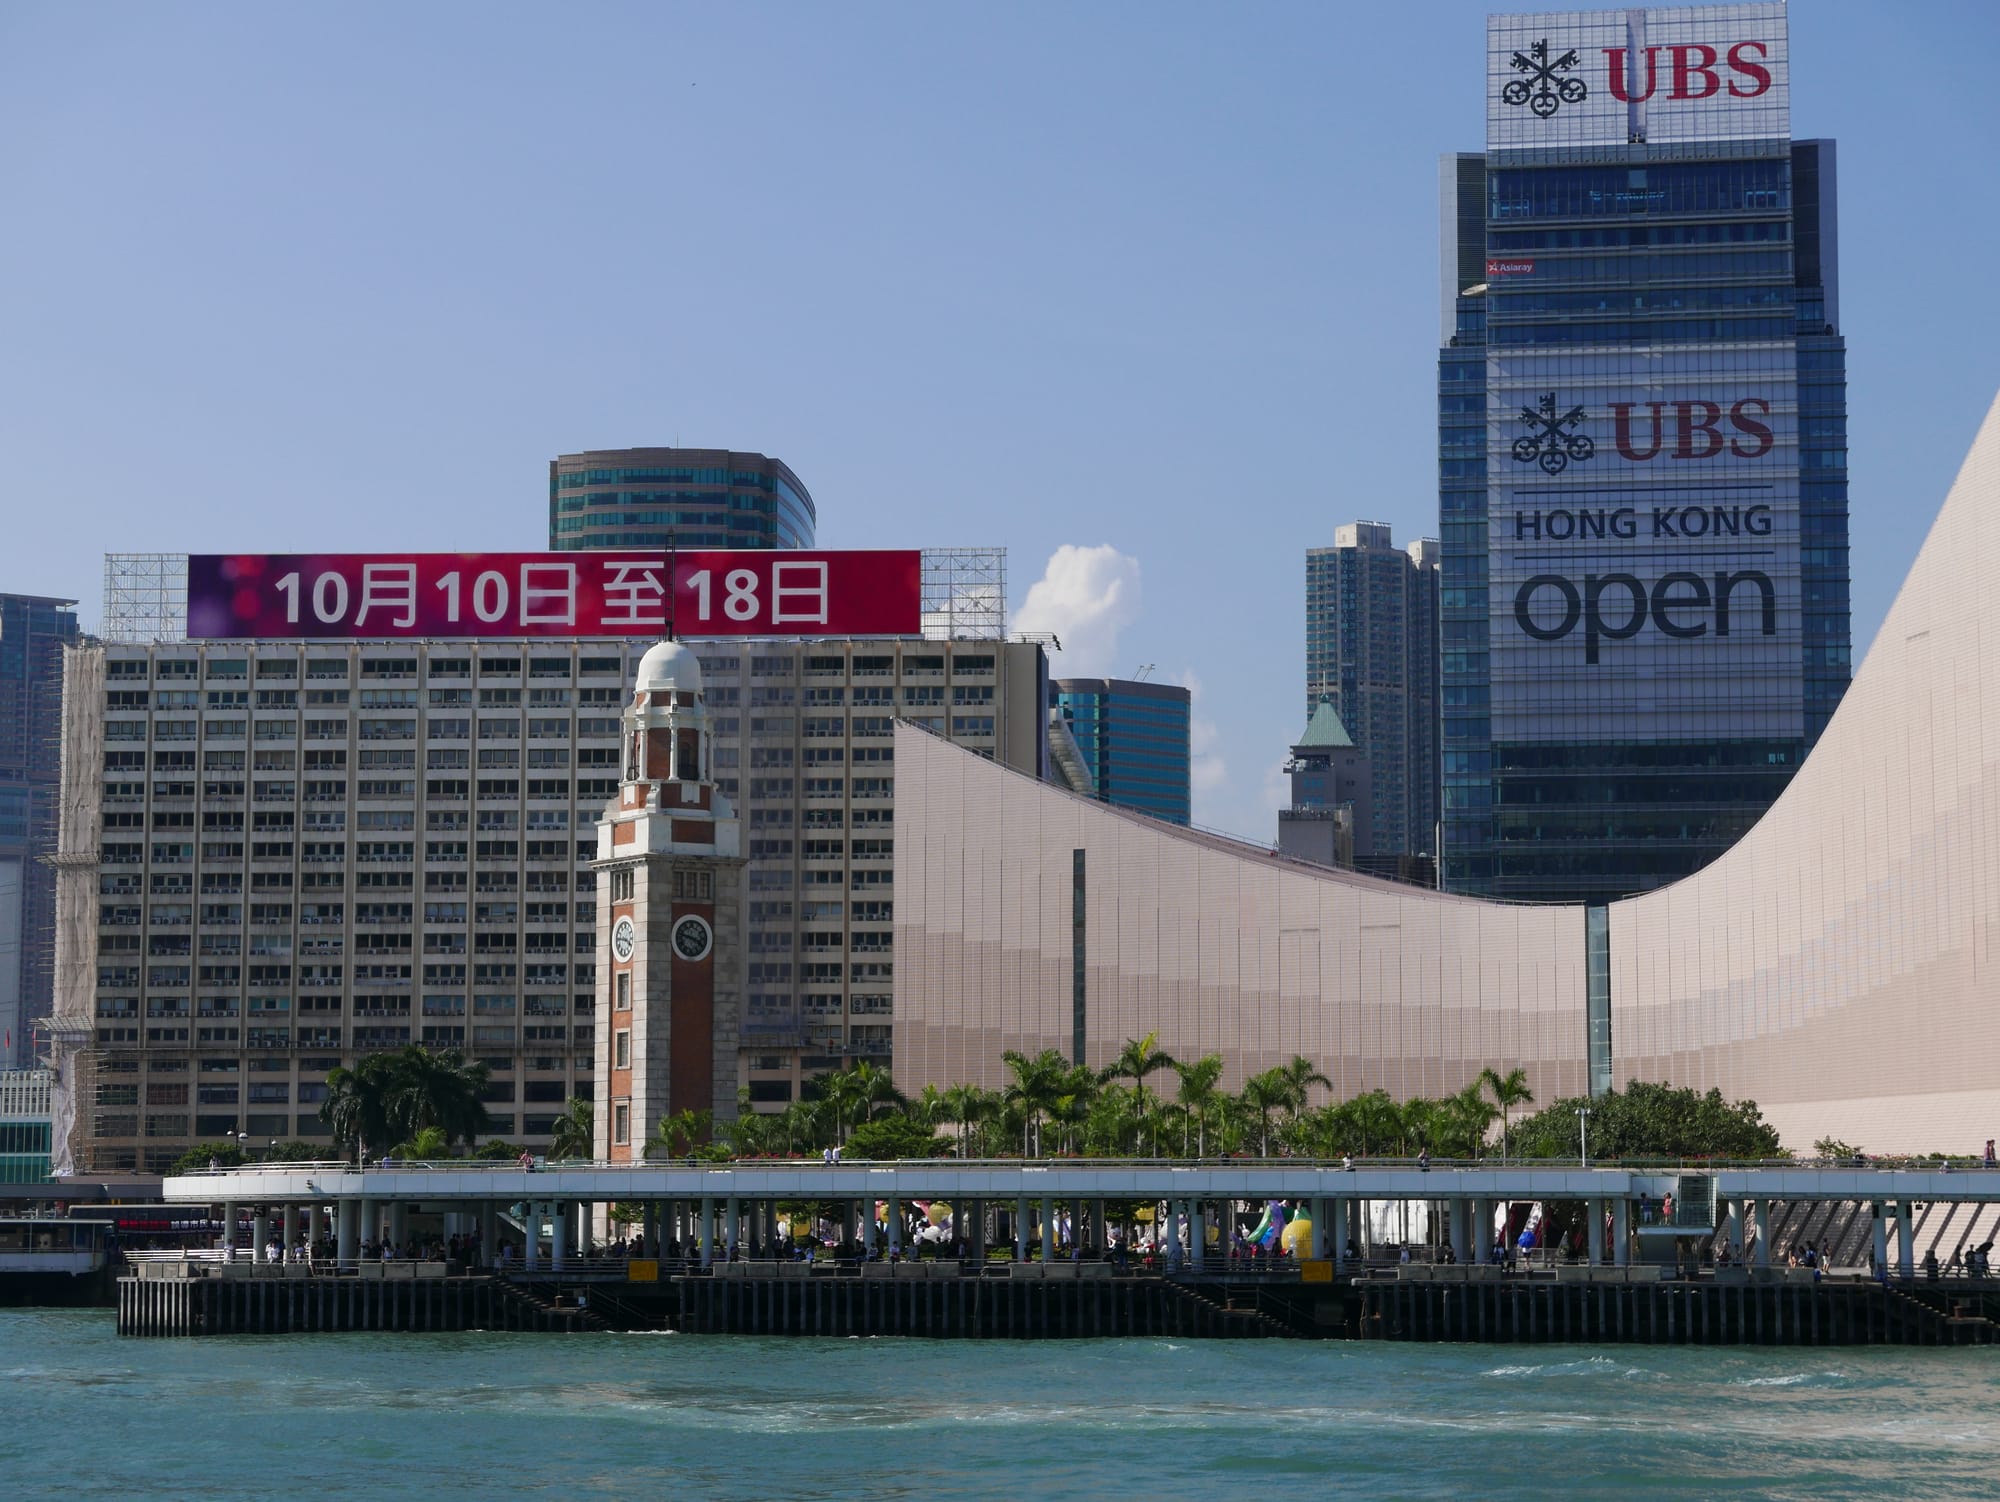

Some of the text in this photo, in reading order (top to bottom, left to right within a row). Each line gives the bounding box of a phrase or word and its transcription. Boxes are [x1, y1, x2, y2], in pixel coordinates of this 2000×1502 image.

[1601, 41, 1772, 103] UBS
[1499, 262, 1533, 273] Asiaray
[1608, 398, 1774, 461] UBS
[1516, 505, 1772, 541] HONG KONG
[1514, 570, 1776, 665] open
